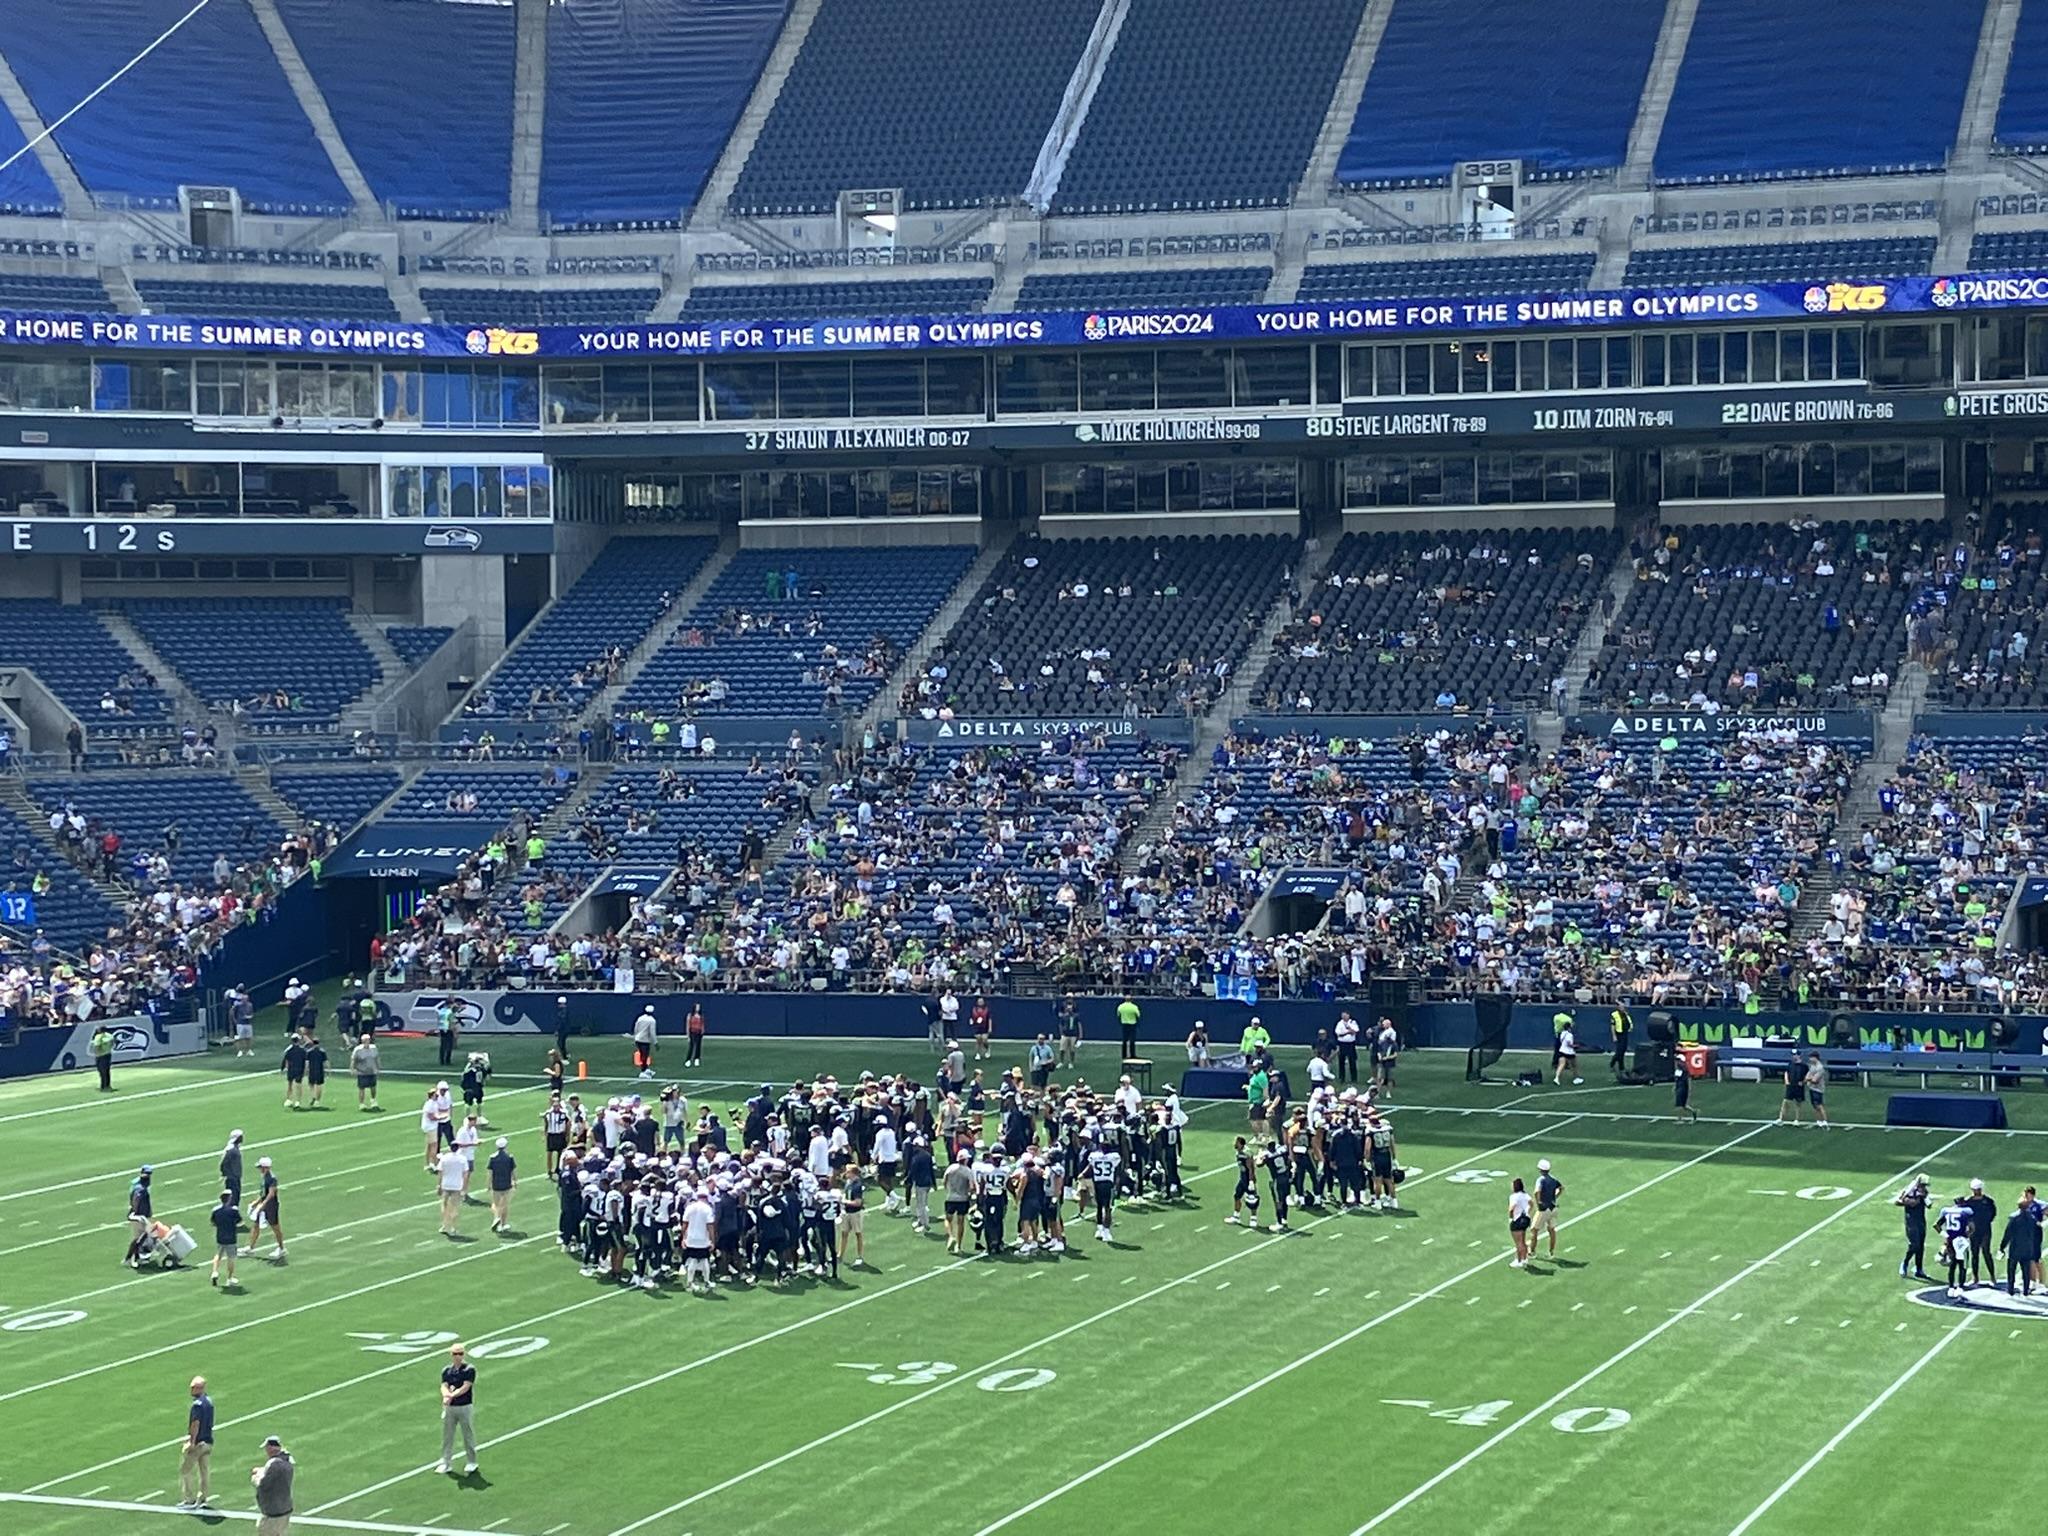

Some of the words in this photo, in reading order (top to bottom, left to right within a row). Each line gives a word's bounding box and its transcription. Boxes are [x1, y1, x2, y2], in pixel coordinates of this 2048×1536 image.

[1464, 162, 1512, 177] 332
[1256, 312, 1320, 331] YOUR
[1329, 308, 1398, 328] HOME
[1406, 306, 1453, 325] FOR
[1462, 303, 1508, 322] THE
[1517, 299, 1623, 321] SUMMER
[1632, 293, 1759, 317] OLYMPICS
[15, 319, 84, 340] HOME
[93, 322, 138, 341] FOR
[147, 324, 193, 343] THE
[201, 326, 302, 346] SUMMER
[310, 329, 425, 350] OLYMPICS
[579, 332, 640, 350] YOUR
[648, 330, 712, 349] HOME
[720, 328, 764, 347] FOR
[772, 328, 815, 346] THE
[824, 324, 920, 344] SUMMER
[929, 321, 1043, 342] OLYMPICS
[1107, 314, 1214, 336] PARIS2024
[1722, 403, 1749, 423] 22
[1750, 402, 1791, 423] DAVE
[1795, 400, 1855, 421] BROWN
[1856, 403, 1893, 420] 76-86
[1960, 395, 2000, 416] PETE
[1306, 417, 1334, 436] 80
[1335, 415, 1381, 436] STEVE
[1384, 413, 1451, 434] LARGENT
[1452, 416, 1486, 432] 76-89
[1533, 410, 1559, 430] 10
[1560, 408, 1591, 429] JIM
[1594, 407, 1637, 428] ZORN
[1638, 409, 1673, 426] 76-84
[745, 432, 769, 450] 37
[776, 430, 828, 449] SHAUN
[834, 427, 925, 448] ALEXANDER
[1101, 421, 1142, 442] MIKE
[1144, 419, 1225, 441] HOLMGREN
[1225, 423, 1260, 439] 99-08
[959, 721, 1025, 736] DELTA
[1635, 717, 1707, 732] DELTA
[369, 867, 420, 878] LUMEN
[7, 897, 27, 920] 12
[1690, 1053, 1704, 1068] G
[1094, 1161, 1113, 1177] 53
[986, 1174, 1005, 1188] 43
[822, 1201, 841, 1217] 23
[1944, 1213, 1961, 1231] 15
